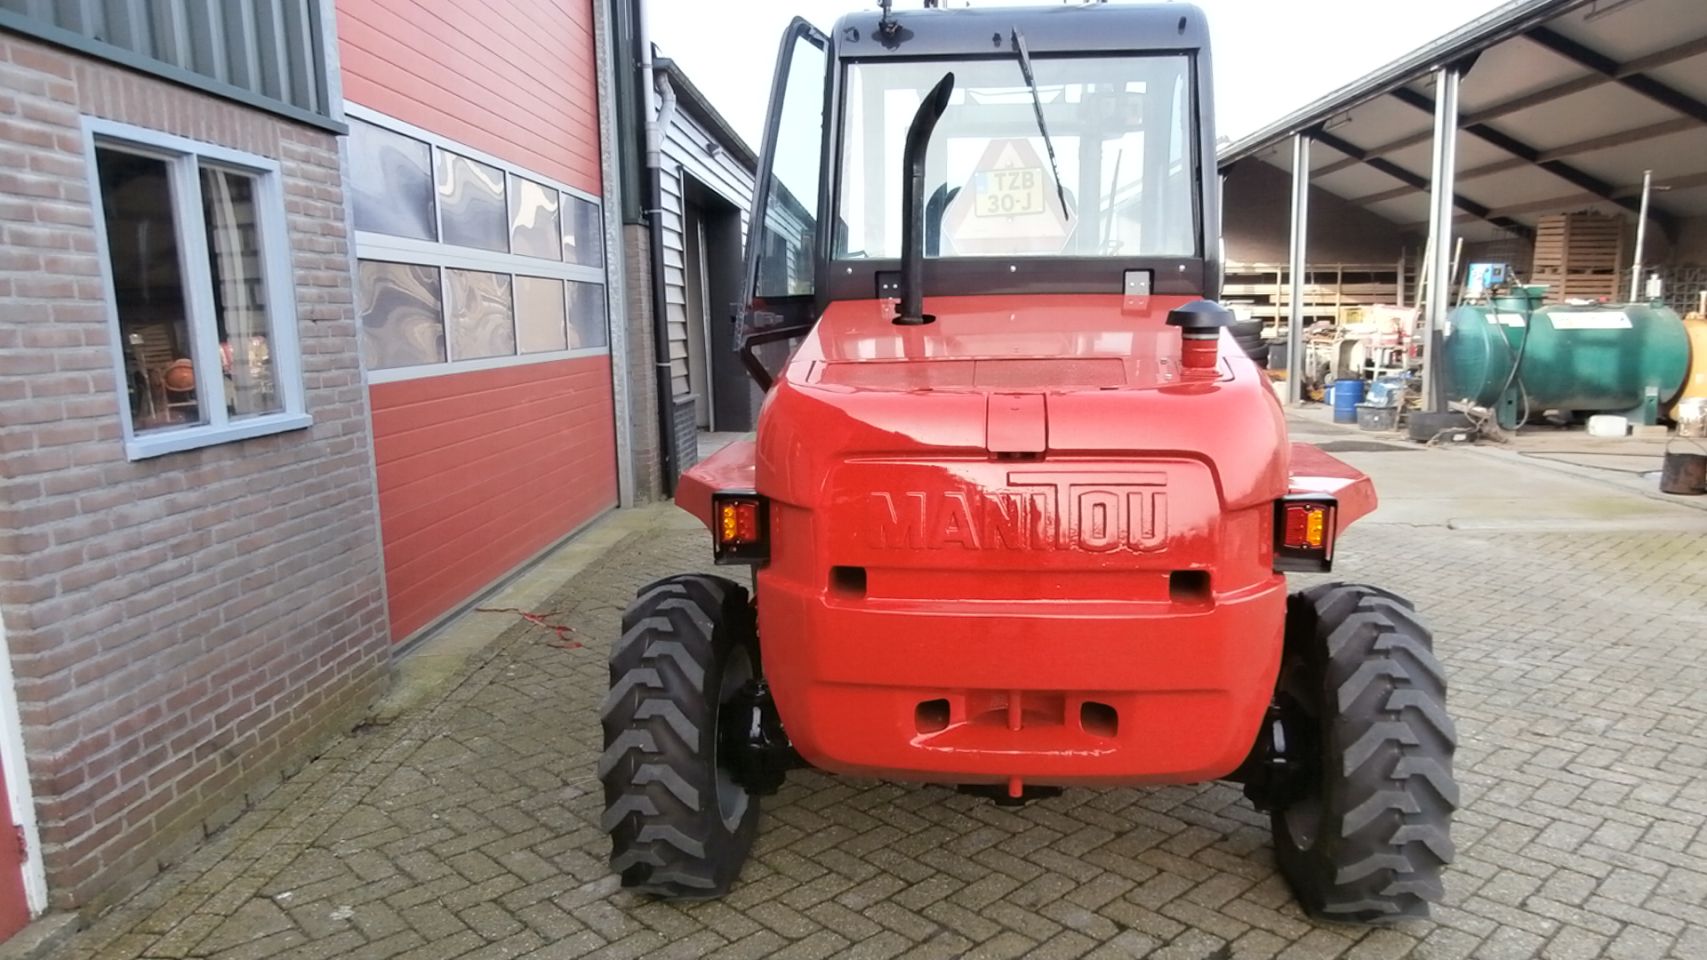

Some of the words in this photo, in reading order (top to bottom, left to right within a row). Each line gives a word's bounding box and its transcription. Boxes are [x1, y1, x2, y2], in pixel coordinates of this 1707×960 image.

[993, 171, 1035, 191] TZB
[987, 192, 1031, 213] 30-J
[868, 471, 1168, 554] MANITOU
